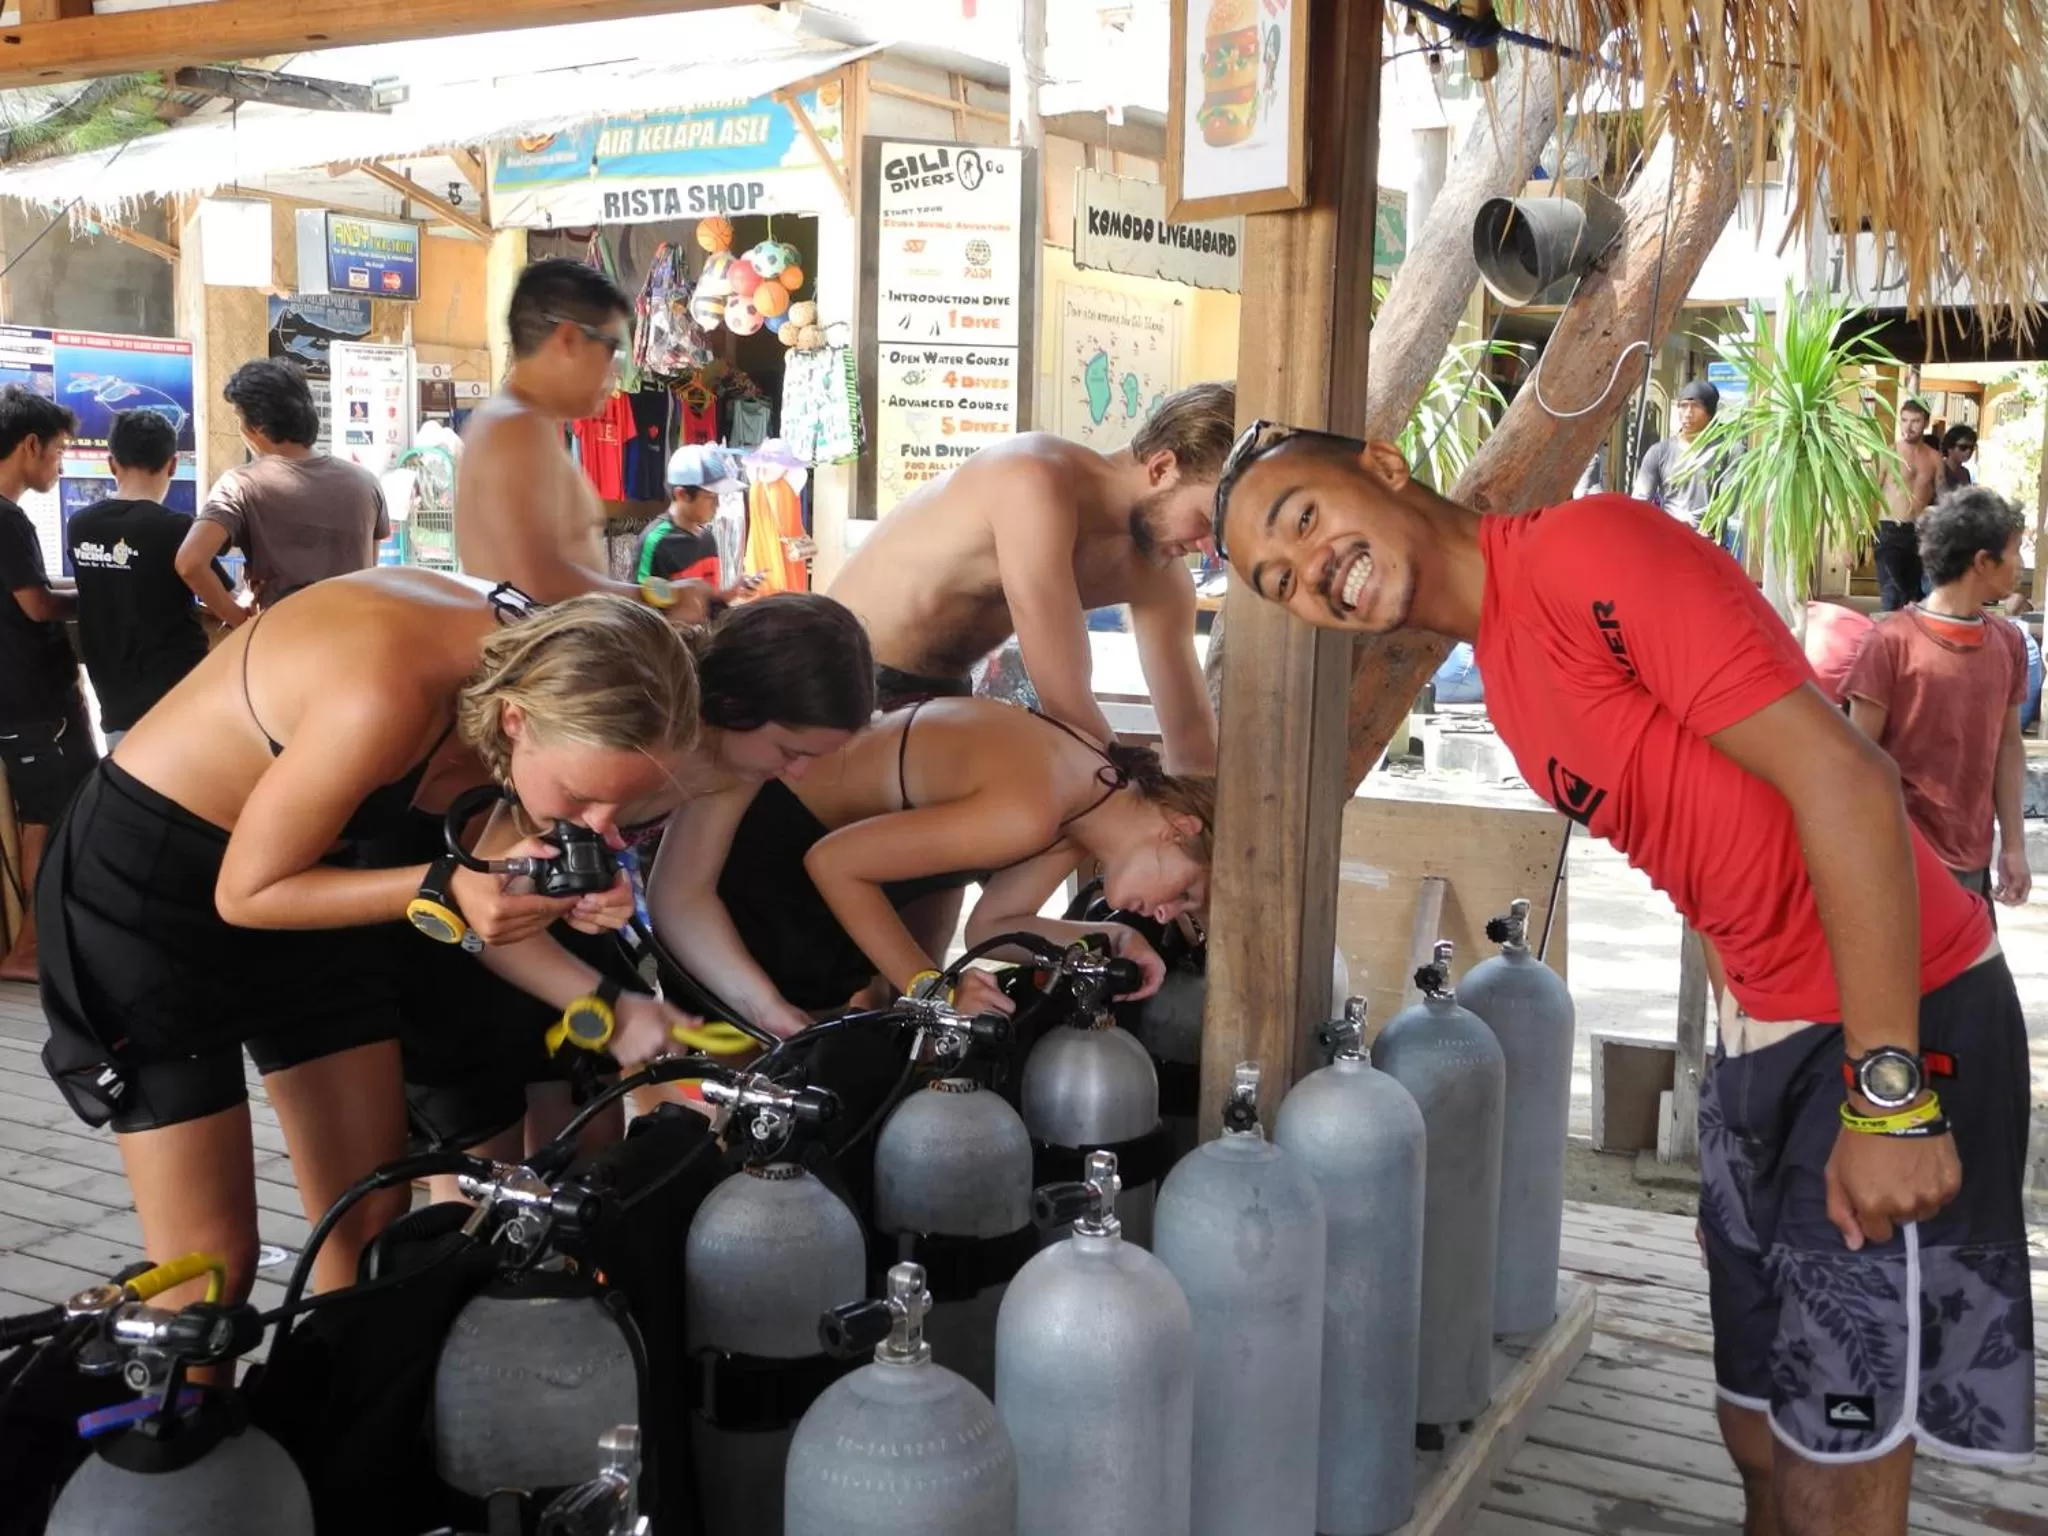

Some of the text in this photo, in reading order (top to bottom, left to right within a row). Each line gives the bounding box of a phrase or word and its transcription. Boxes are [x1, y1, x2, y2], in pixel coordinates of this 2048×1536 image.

[597, 114, 770, 156] AIR KELAPA ASLI
[885, 149, 950, 181] GILI
[891, 173, 955, 193] DIVERS
[604, 182, 765, 218] RISTA SHOP
[1088, 206, 1237, 257] KOMODO LIVEABOARD
[982, 295, 1010, 306] DIVE
[961, 315, 1000, 329] DIVE
[942, 370, 958, 389] 4
[941, 416, 956, 435] 5
[935, 444, 980, 457] DIVIN
